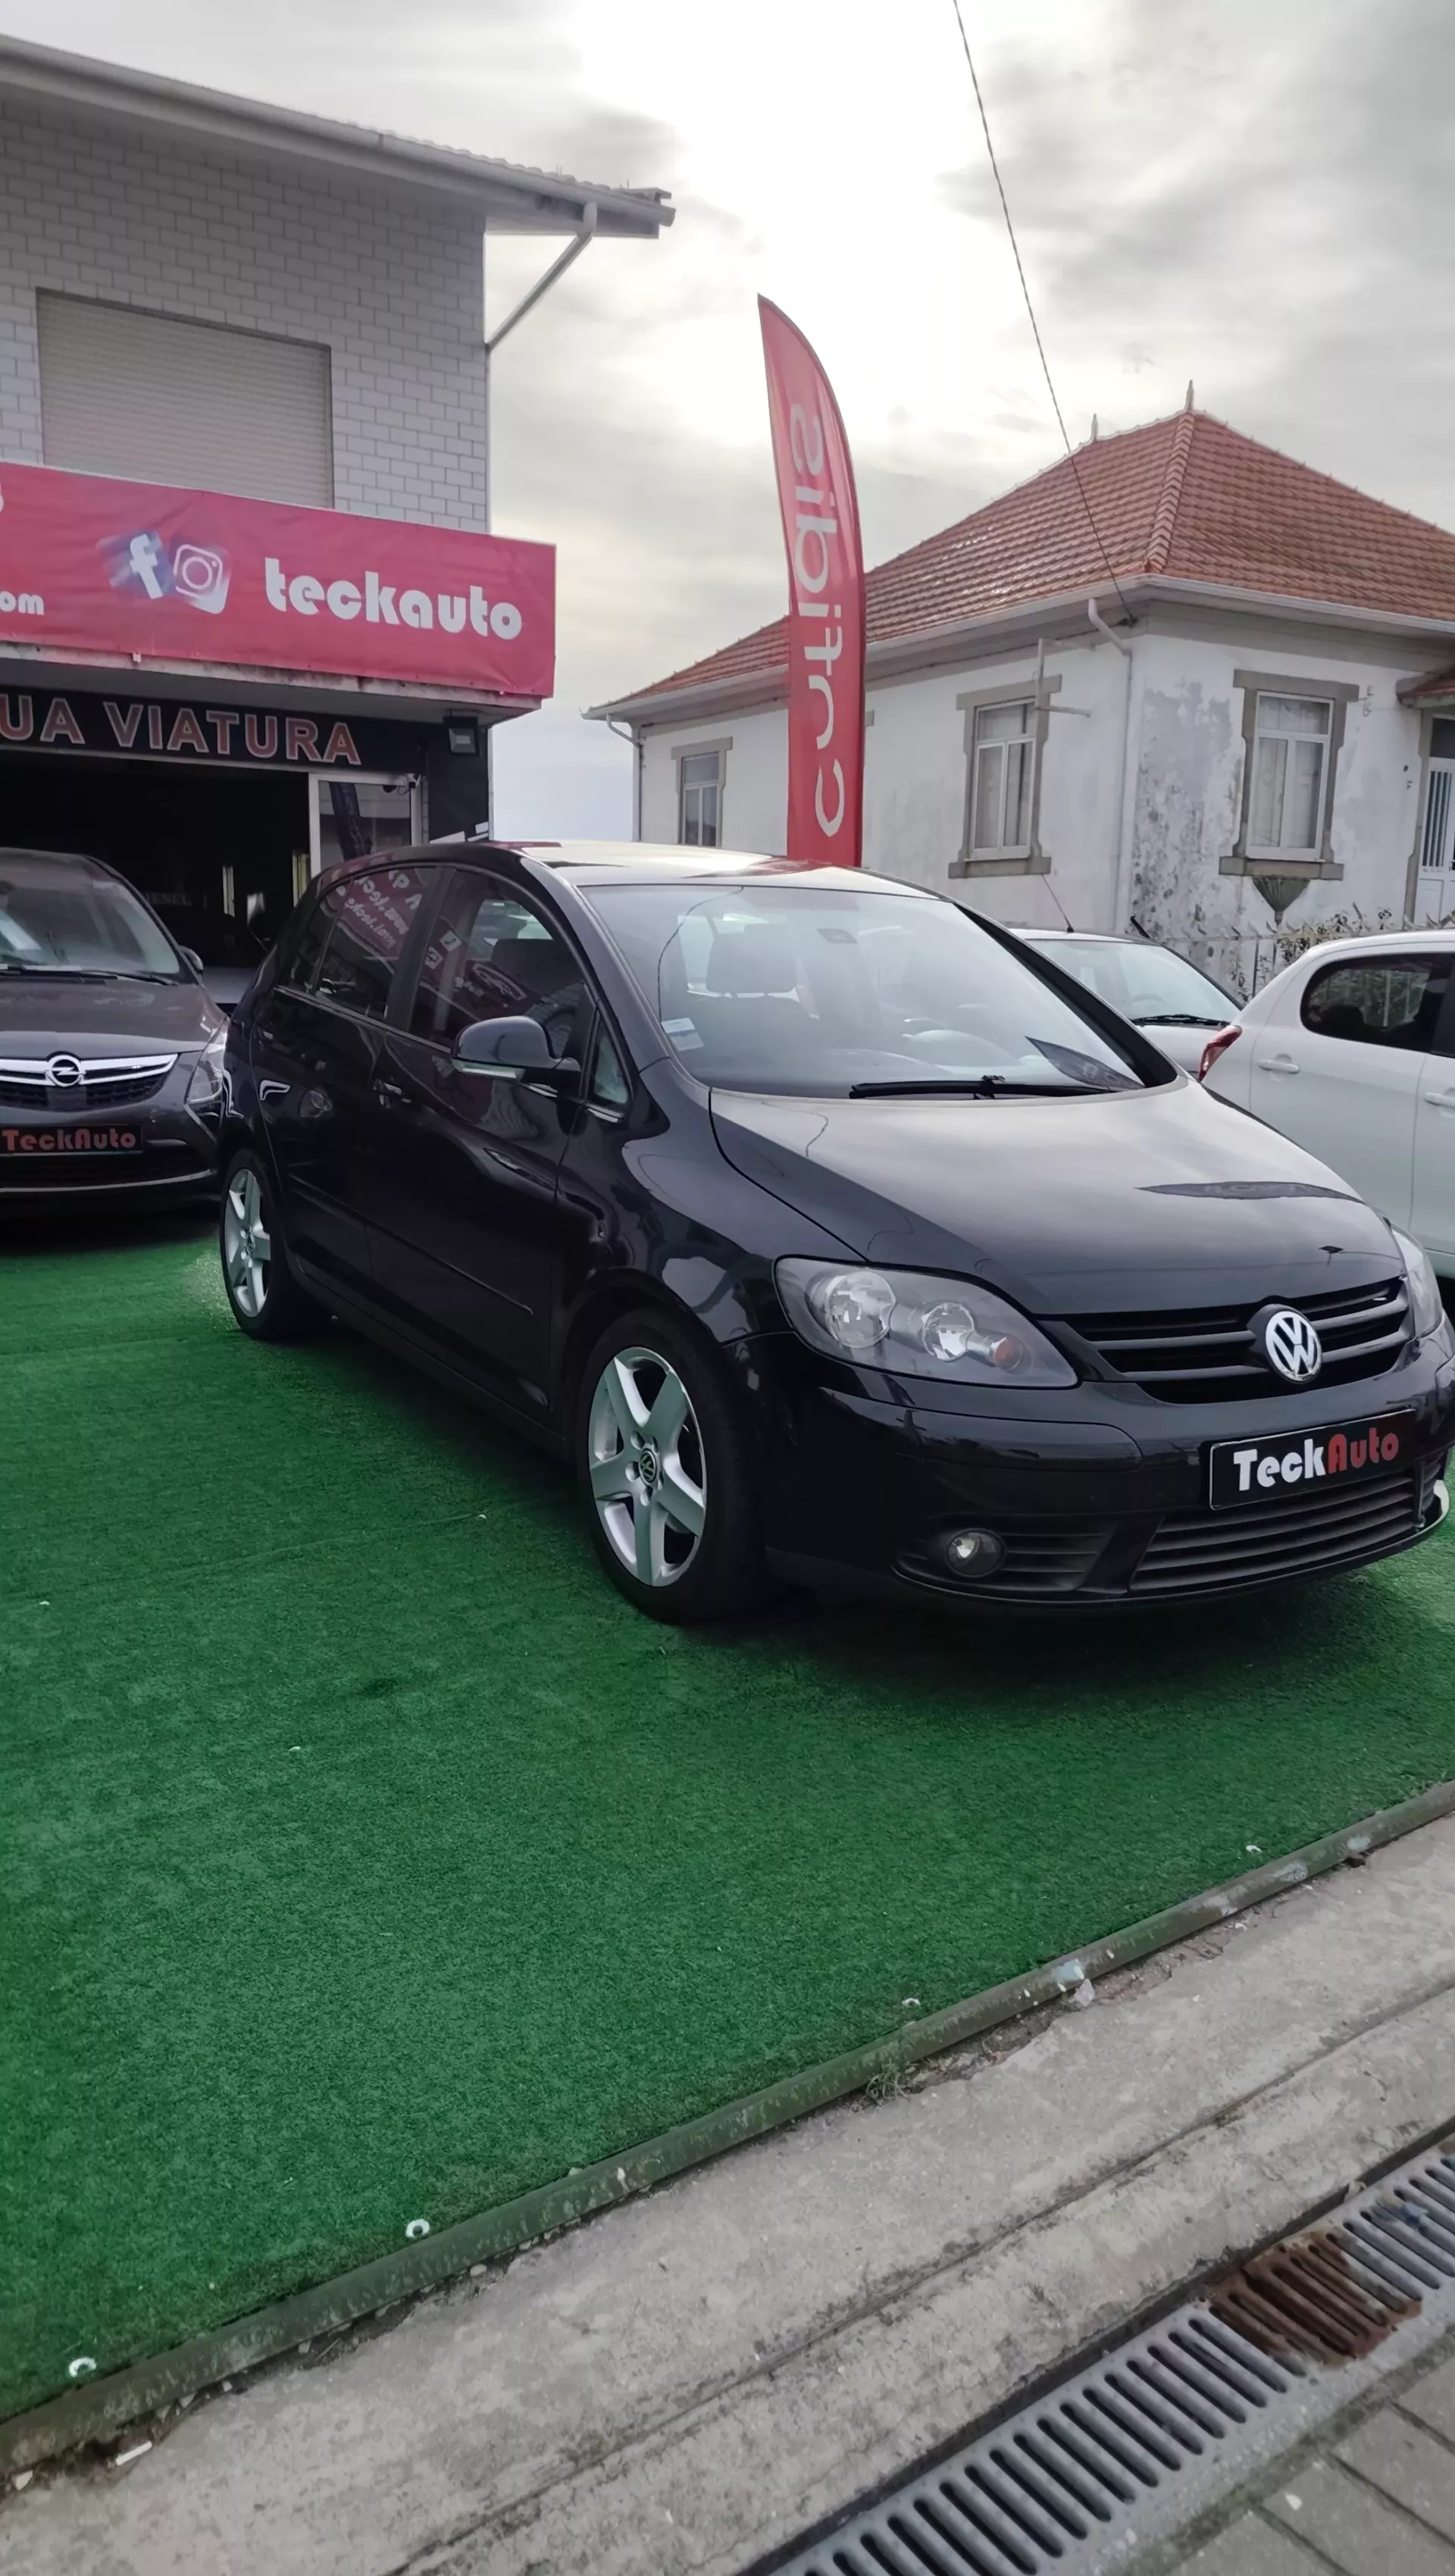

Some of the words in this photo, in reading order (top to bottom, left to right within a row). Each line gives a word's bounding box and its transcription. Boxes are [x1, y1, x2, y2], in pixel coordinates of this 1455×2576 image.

[264, 557, 523, 640] teckauto
[102, 700, 362, 765] VIATURA
[2, 1127, 136, 1151] TeckAuto
[1233, 1427, 1400, 1491] TeckAuto
